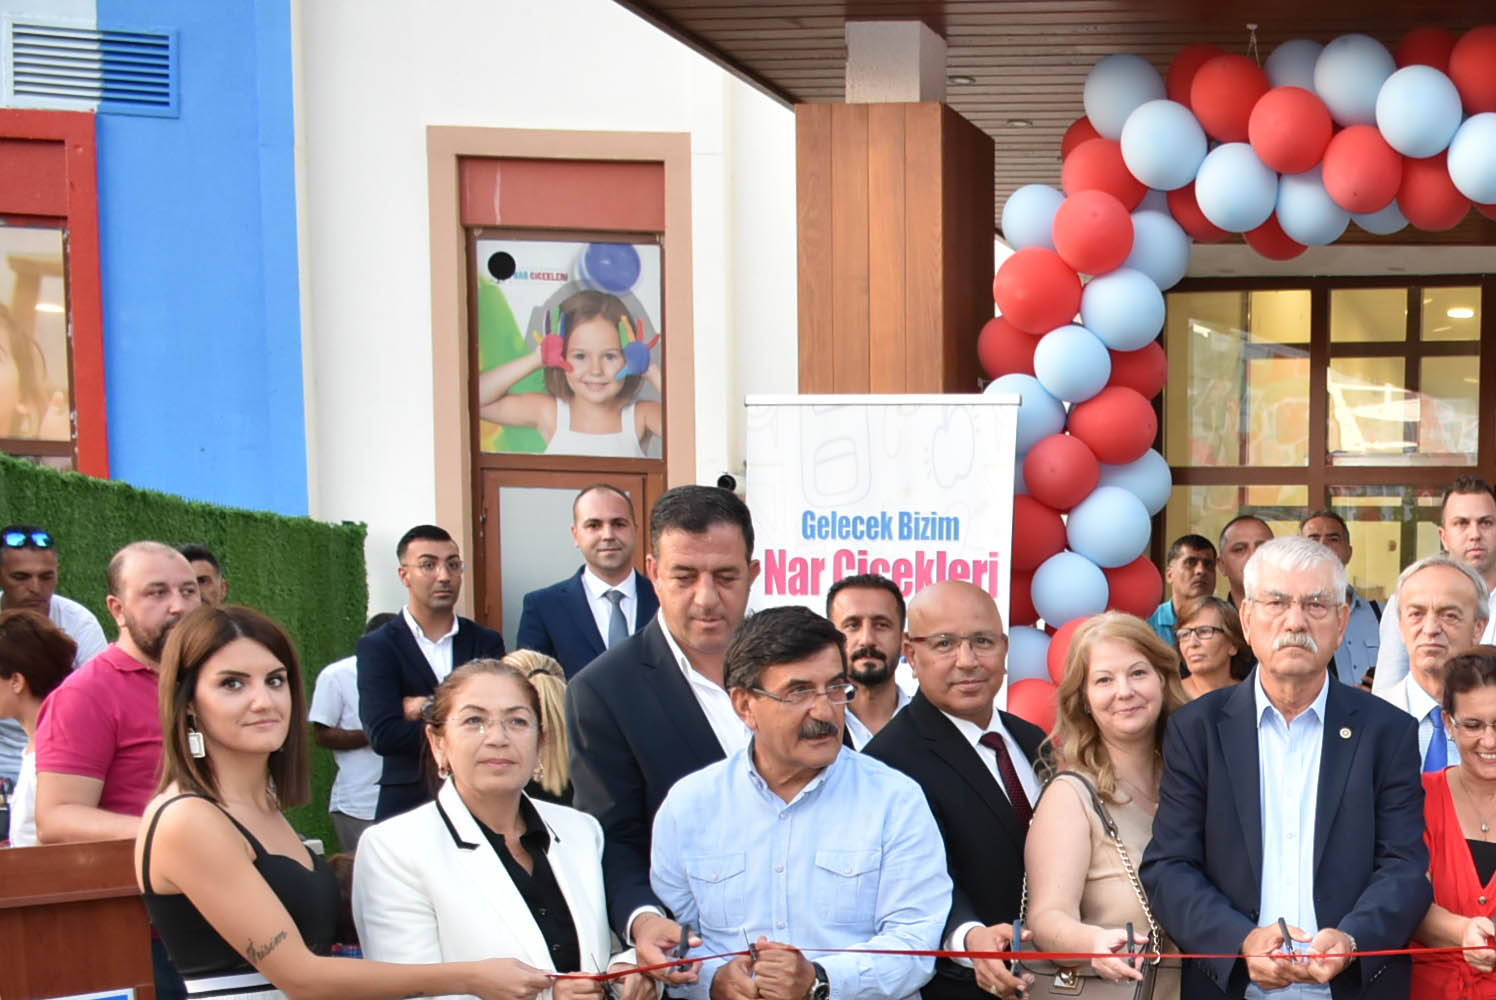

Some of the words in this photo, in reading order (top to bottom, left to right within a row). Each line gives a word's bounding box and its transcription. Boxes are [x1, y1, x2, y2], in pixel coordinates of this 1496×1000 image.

[801, 510, 893, 540] Gelecek
[899, 511, 960, 541] Bizim
[764, 548, 825, 596] Nar
